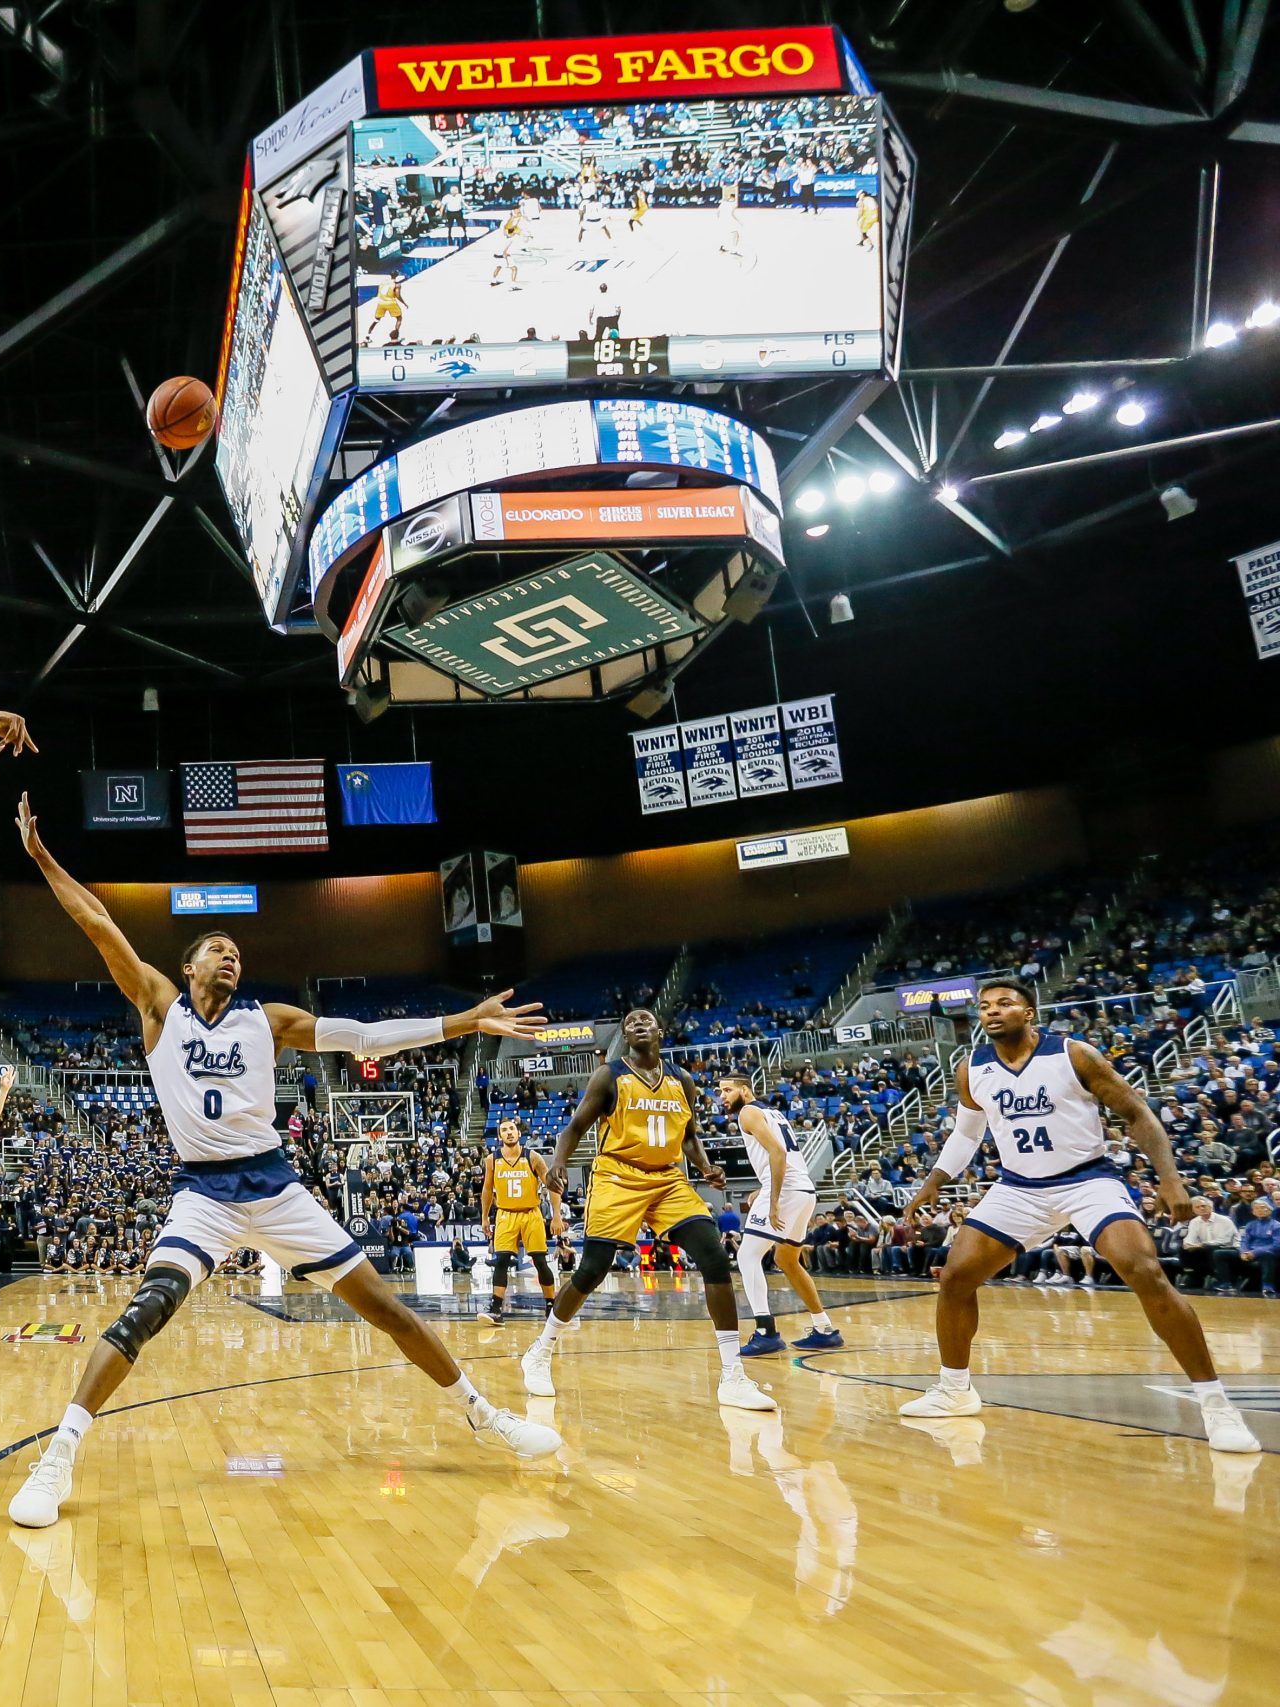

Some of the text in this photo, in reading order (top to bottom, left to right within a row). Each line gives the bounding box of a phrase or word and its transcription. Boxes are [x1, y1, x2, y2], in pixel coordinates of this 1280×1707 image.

[398, 43, 815, 93] WELLS FARGO
[256, 124, 288, 159] Spine
[309, 190, 338, 309] WOLF PACK
[824, 333, 855, 345] FLS
[384, 348, 414, 361] FLS
[430, 347, 481, 363] NEVADA
[832, 350, 846, 366] 0
[392, 366, 405, 381] 0
[596, 363, 624, 375] PER
[599, 401, 646, 411] PLAYER
[479, 500, 495, 538] ROW
[657, 505, 693, 519] SILVER
[696, 505, 735, 518] LEGACY
[405, 523, 445, 546] NISSAN
[788, 704, 828, 724] WBI
[733, 714, 776, 734] WNIT
[796, 725, 824, 737] 2018
[685, 724, 726, 744] WNIT
[746, 735, 765, 745] 2011
[789, 731, 834, 743] SEMI FINAL
[636, 734, 676, 752] WNIT
[696, 744, 717, 754] 2010
[737, 739, 780, 753] SECOND
[795, 737, 829, 749] ROUND
[647, 753, 669, 763] 2007
[694, 750, 721, 761] FIRST
[742, 748, 775, 760] ROUND
[793, 748, 836, 765] NEVADA
[646, 759, 671, 770] FIRST
[693, 757, 725, 768] ROUND
[741, 758, 782, 774] NEVADA
[644, 766, 675, 777] ROUND
[691, 767, 731, 783] NEVADA
[794, 772, 839, 784] BASKETBALL
[643, 776, 681, 791] NEVADA
[742, 781, 785, 793] BASKETBALL
[115, 785, 138, 802] N
[692, 790, 734, 801] BASKETBALL
[643, 798, 684, 810] BASKETBALL
[798, 849, 817, 857] WOLF
[803, 843, 833, 851] NEVADA
[177, 899, 206, 908] LIGHT
[950, 988, 973, 999] HILL
[534, 1026, 593, 1042] QDOBA
[842, 1026, 865, 1040] 36
[182, 1038, 247, 1081] Pack
[528, 1059, 548, 1070] 34
[363, 1061, 377, 1079] 15
[204, 1089, 222, 1120] 0
[627, 1097, 682, 1112] LANCERS
[991, 1085, 1056, 1122] Pack
[647, 1114, 666, 1148] 11
[1012, 1126, 1054, 1153] 24
[497, 1170, 528, 1178] LANCERS
[506, 1179, 523, 1198] 15
[750, 1214, 766, 1227] Pack
